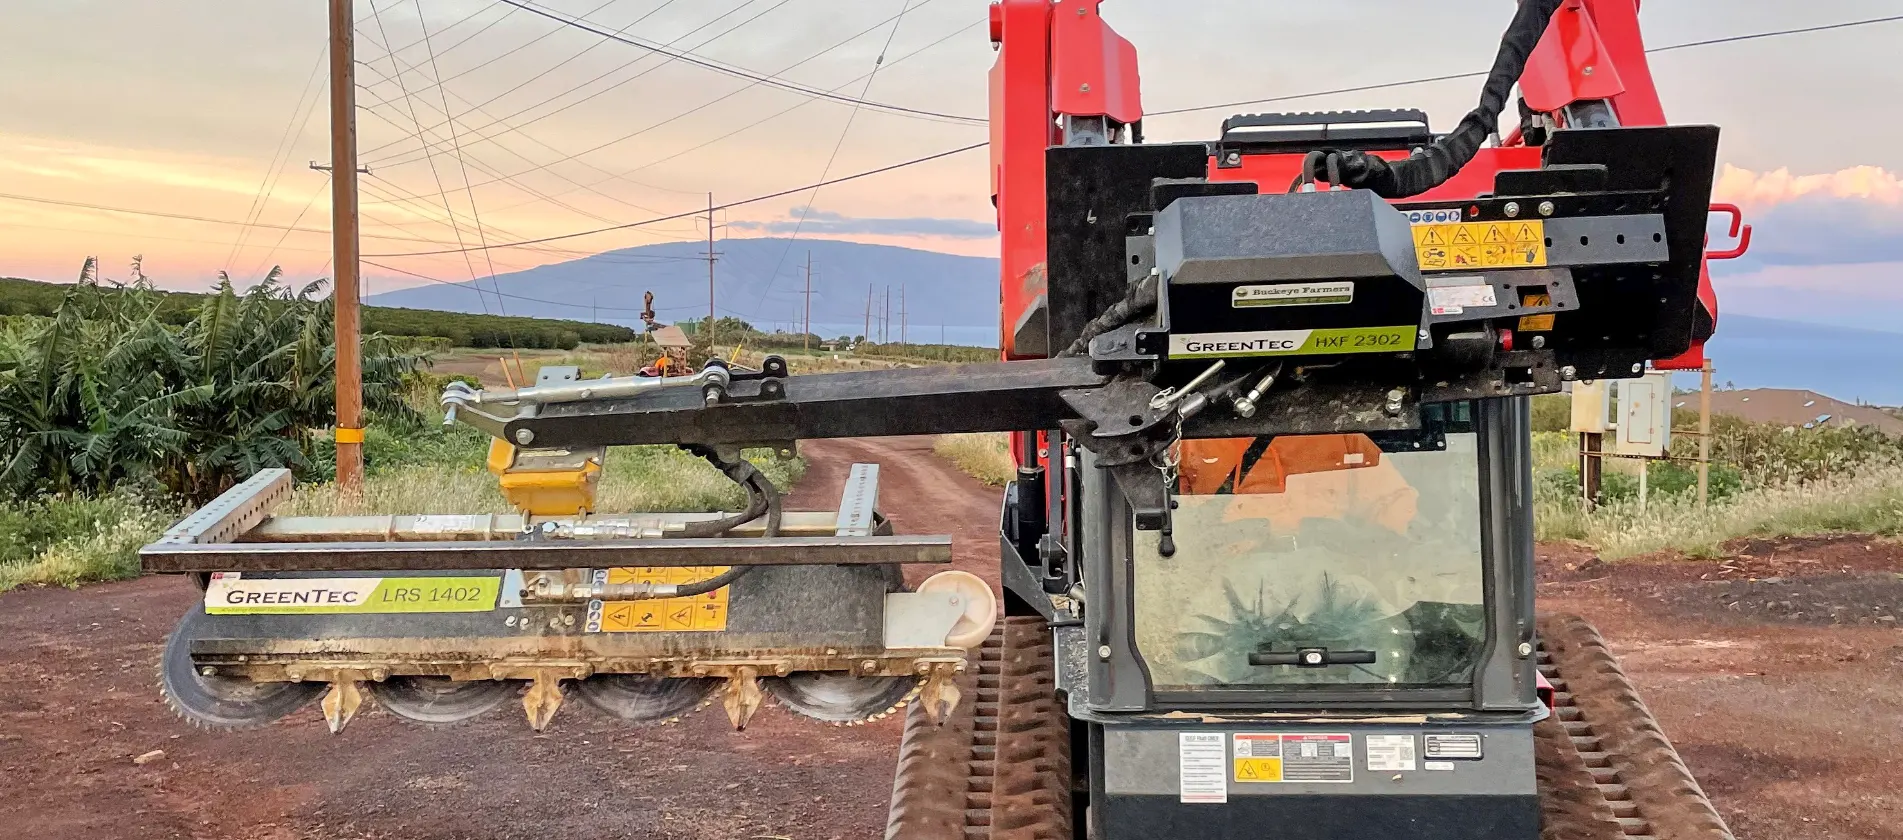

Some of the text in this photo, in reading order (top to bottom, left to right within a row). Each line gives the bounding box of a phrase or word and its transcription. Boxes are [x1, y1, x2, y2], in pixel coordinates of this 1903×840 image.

[1252, 286, 1350, 296] Buckeye Farmers
[1186, 333, 1401, 352] GREENTEC HXF 2302
[226, 586, 481, 605] GREENTEC LRS 1402
